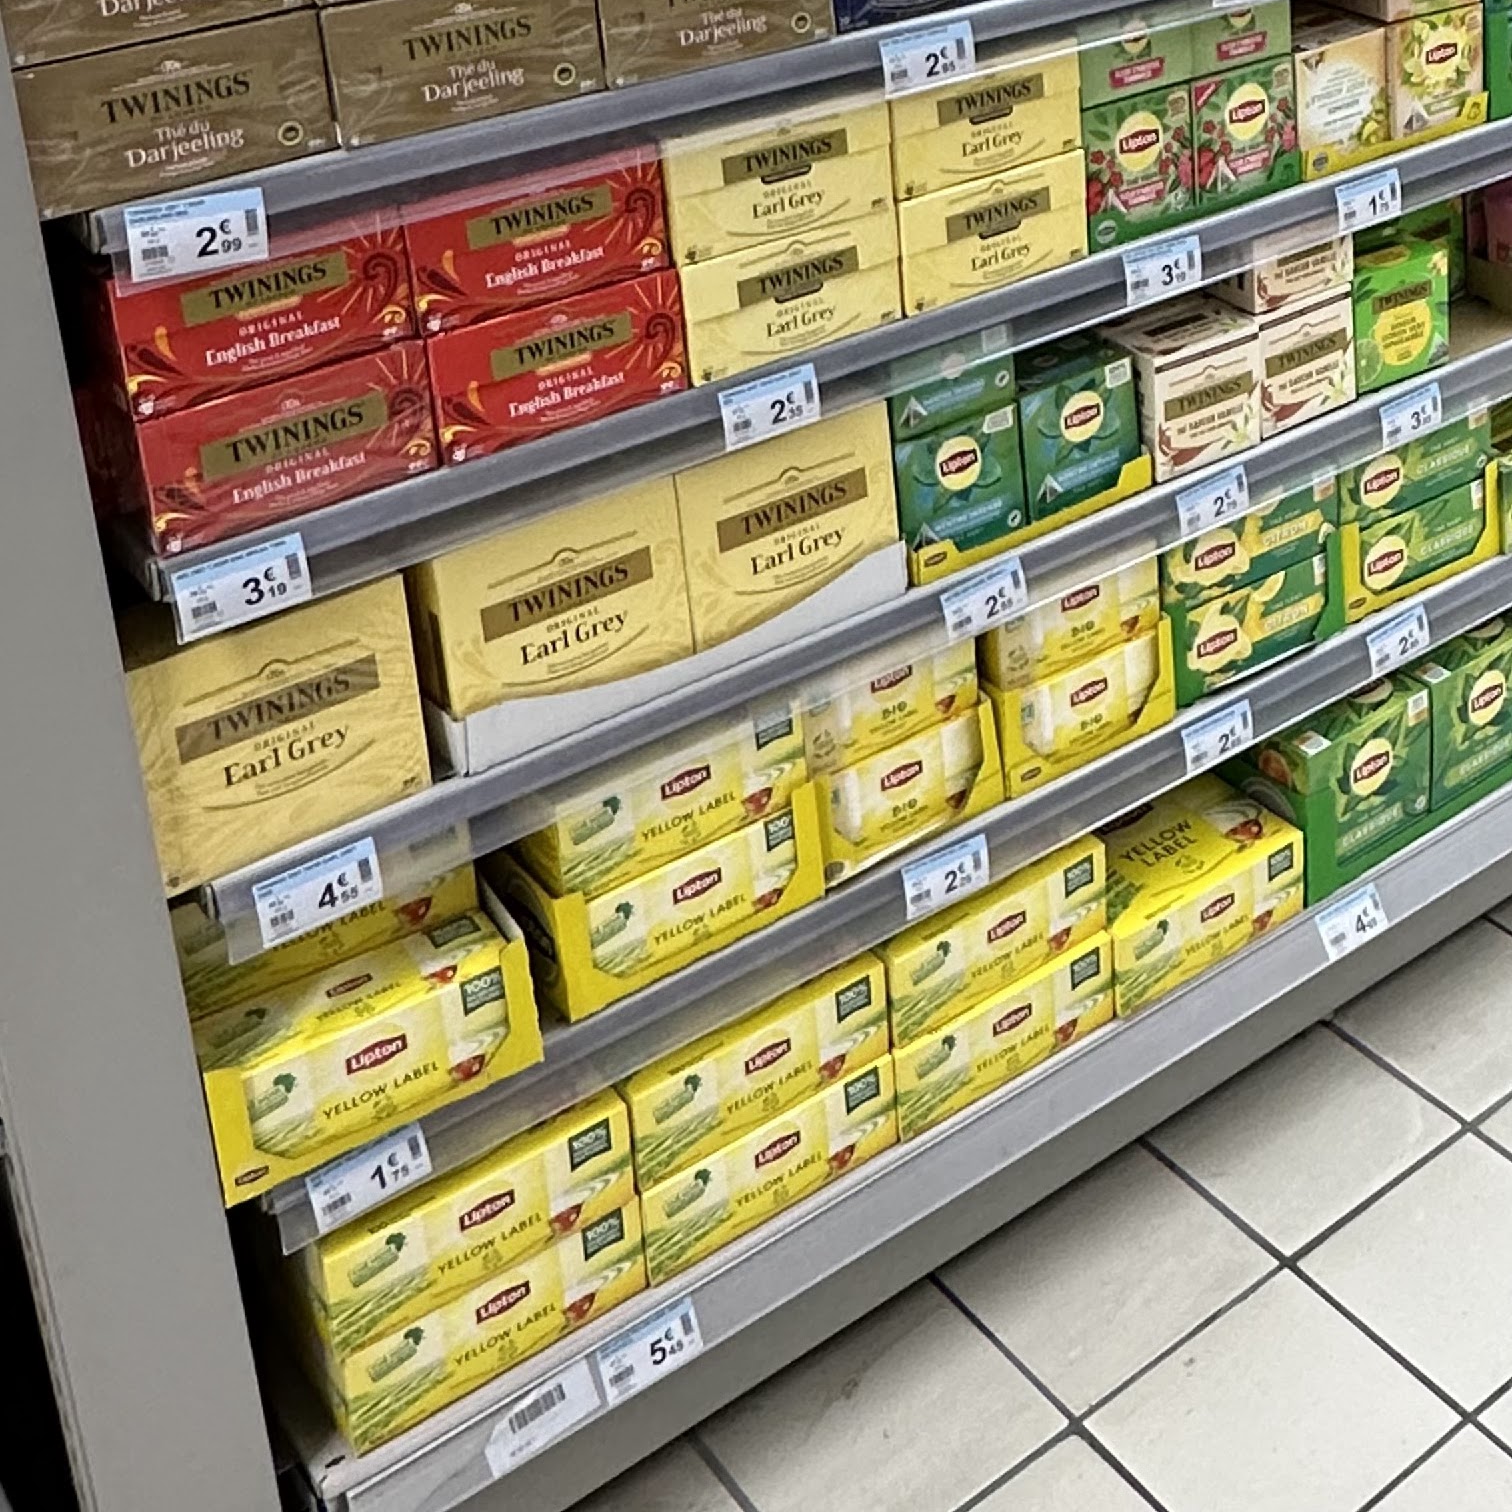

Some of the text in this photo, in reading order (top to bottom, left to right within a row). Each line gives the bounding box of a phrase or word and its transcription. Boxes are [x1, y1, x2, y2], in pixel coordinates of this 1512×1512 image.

[680, 16, 767, 46] Darjeeling
[125, 127, 245, 168] Darjeeling
[743, 138, 832, 173] TWININGS
[962, 129, 1024, 157] Earl Grey
[1120, 130, 1159, 154] Lipton
[962, 195, 1039, 232] TWININGS
[209, 262, 328, 309] TWININGS
[206, 314, 340, 366] English Breakfast
[239, 311, 303, 336] ORIGINAL
[514, 318, 615, 365] TWININGS
[509, 371, 625, 419] English Breakfast
[1176, 379, 1242, 411] TWININGS
[232, 451, 367, 505] English Breakfast
[940, 450, 978, 476] Lipton
[741, 480, 848, 537] TWININGS
[750, 527, 846, 575] Earl Grey
[1195, 541, 1236, 571] Lipton
[507, 564, 629, 623] TWININGS
[520, 611, 628, 666] Earl Grey
[546, 606, 600, 633] ORIGINAL
[207, 673, 351, 741] TWININGS
[1470, 682, 1503, 711] Lipton
[224, 725, 350, 788] Earl Grey
[254, 721, 316, 751] ORIGINAL
[881, 764, 922, 789] Lipton
[641, 791, 736, 841] YELLOW LABEL
[1119, 819, 1194, 864] YELLOW
[1142, 835, 1196, 868] LABEL
[674, 872, 721, 902] Lipton
[1201, 894, 1235, 919] Lipton
[654, 893, 747, 946] YELLOW LABEL
[971, 931, 1045, 979] YELLOW LABEL
[347, 1036, 407, 1073] Lipton
[323, 1061, 440, 1120] YELLOW LABEL
[755, 1131, 801, 1169] Lipton
[735, 1151, 823, 1207] YELLOW LABEL
[477, 1283, 530, 1324] Lipton
[453, 1303, 557, 1367] YELLOW LABEL
